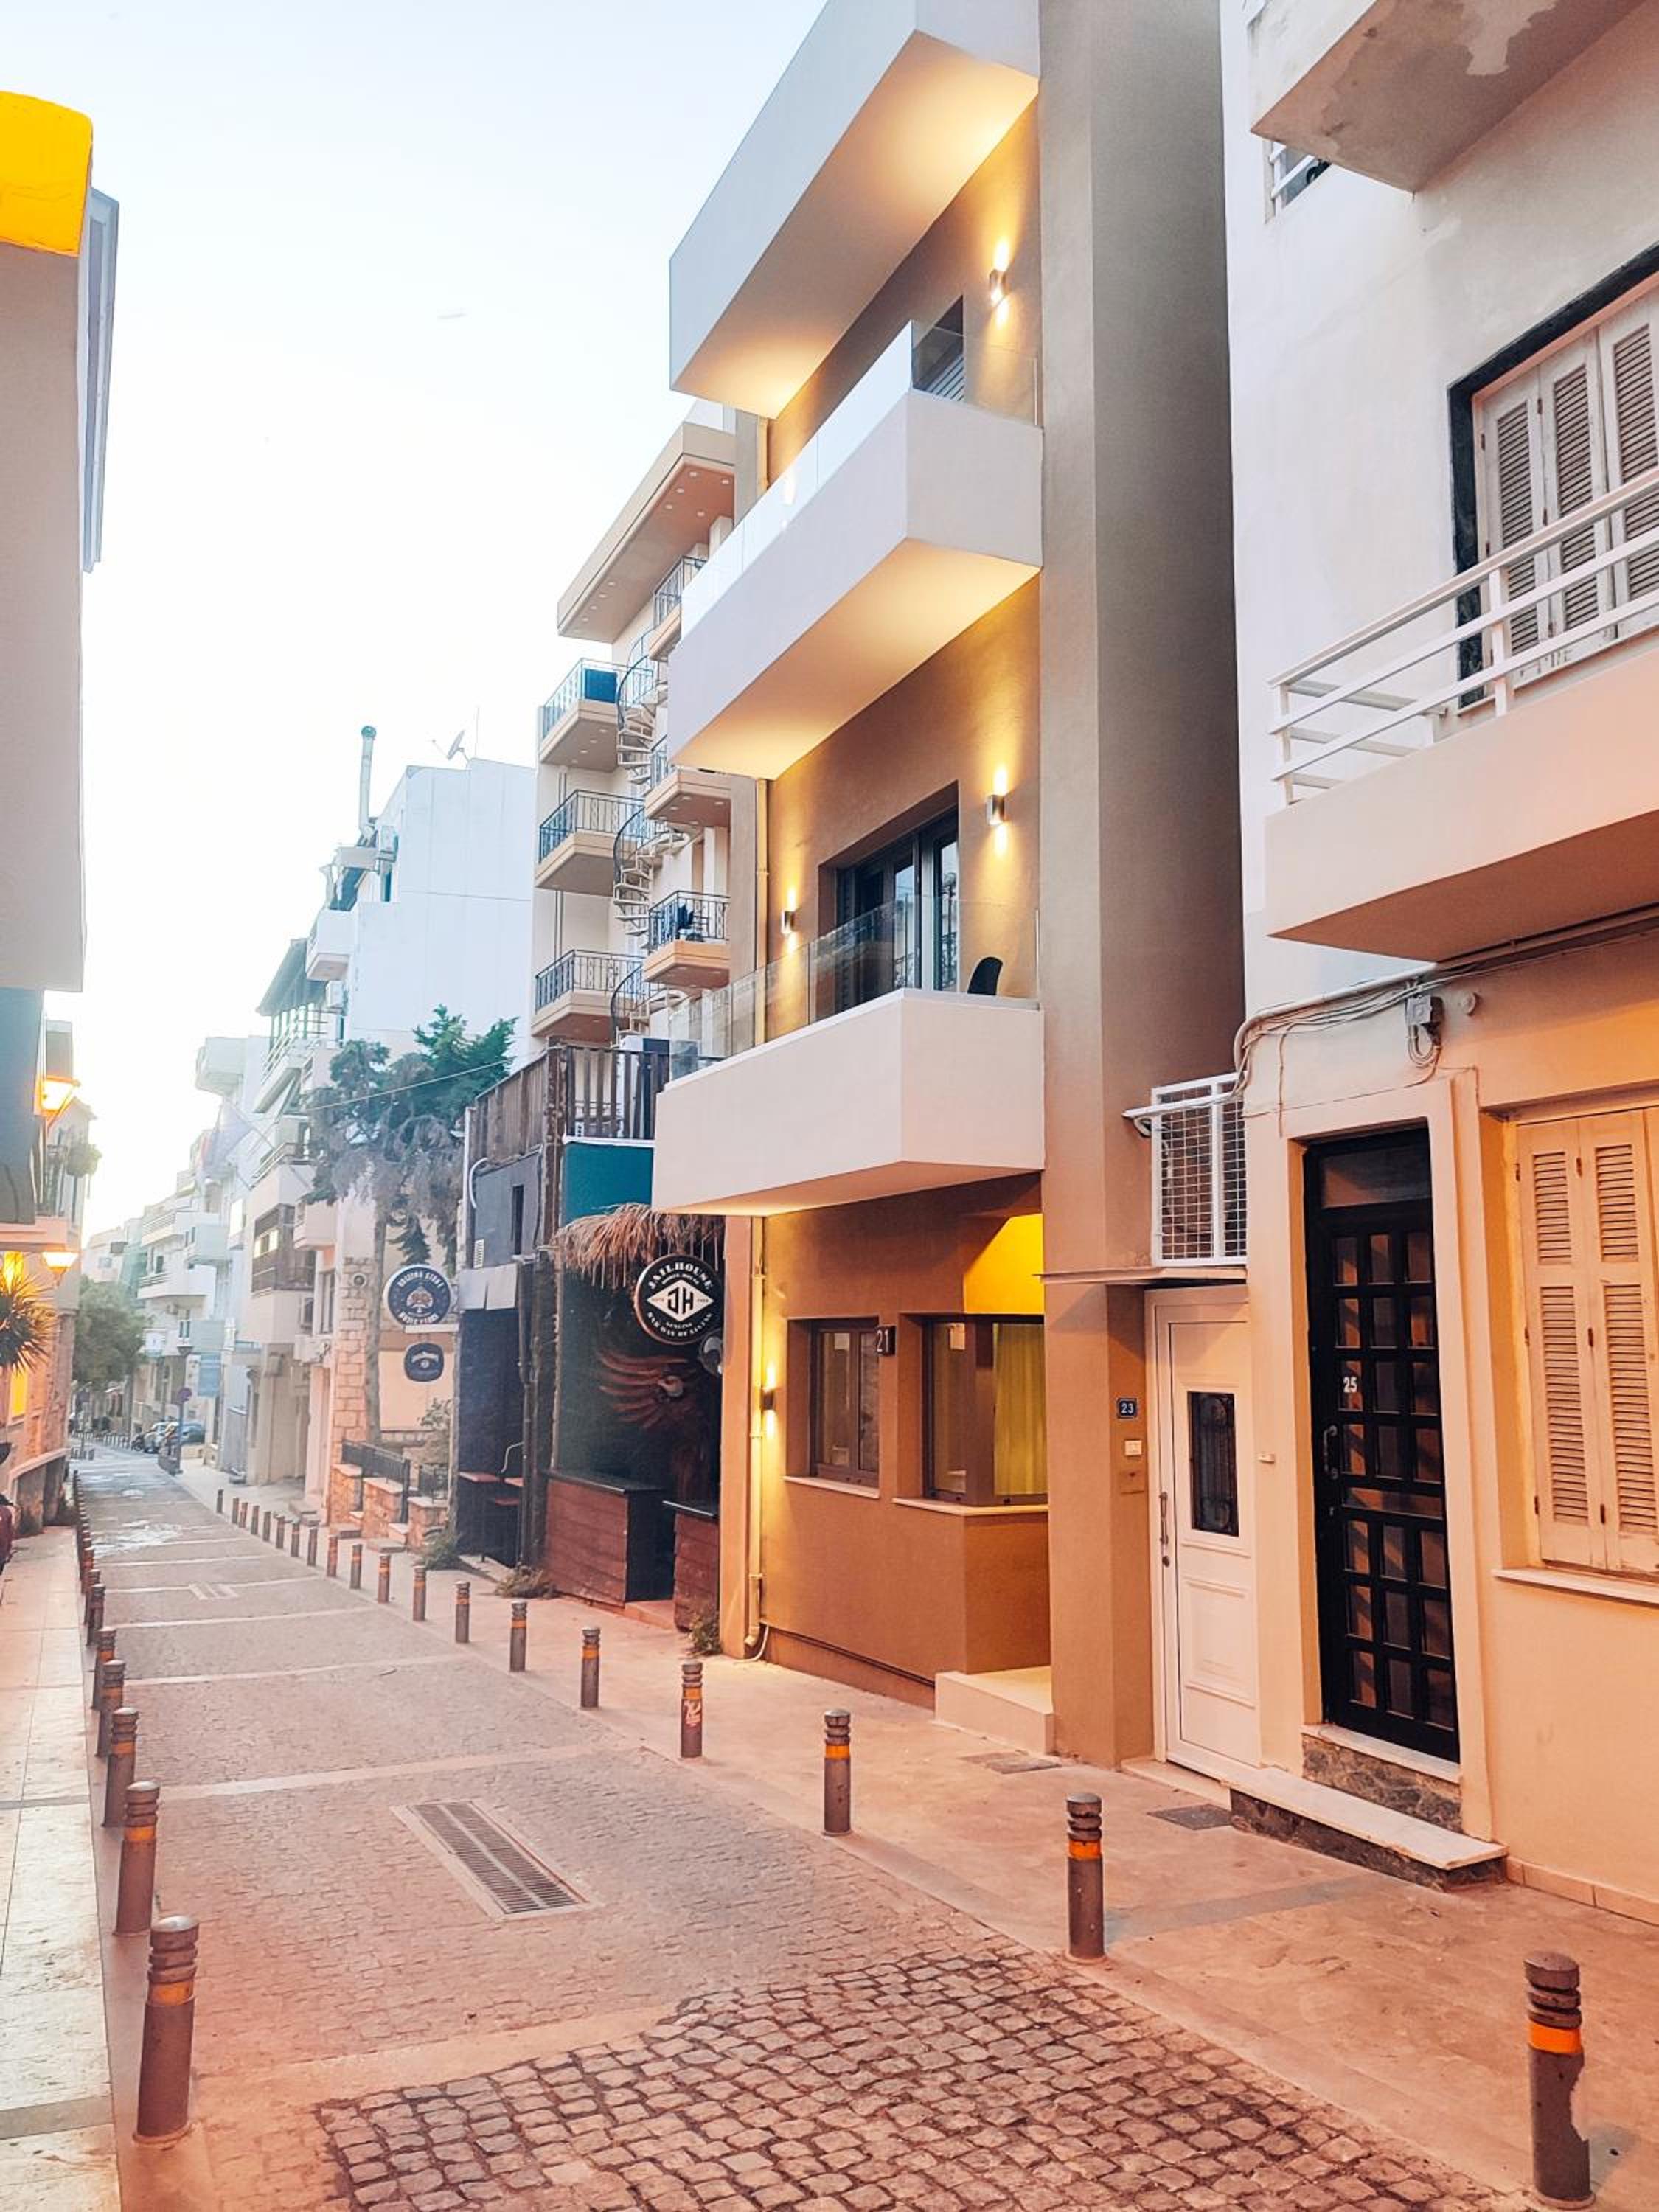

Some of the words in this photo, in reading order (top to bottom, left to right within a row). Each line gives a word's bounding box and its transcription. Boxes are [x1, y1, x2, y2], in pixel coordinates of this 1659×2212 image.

[648, 1262, 713, 1290] JAILHOUSE
[667, 1286, 694, 1315] JH
[876, 1329, 889, 1353] 21
[1343, 1376, 1357, 1393] 25
[1121, 1402, 1134, 1414] 23
